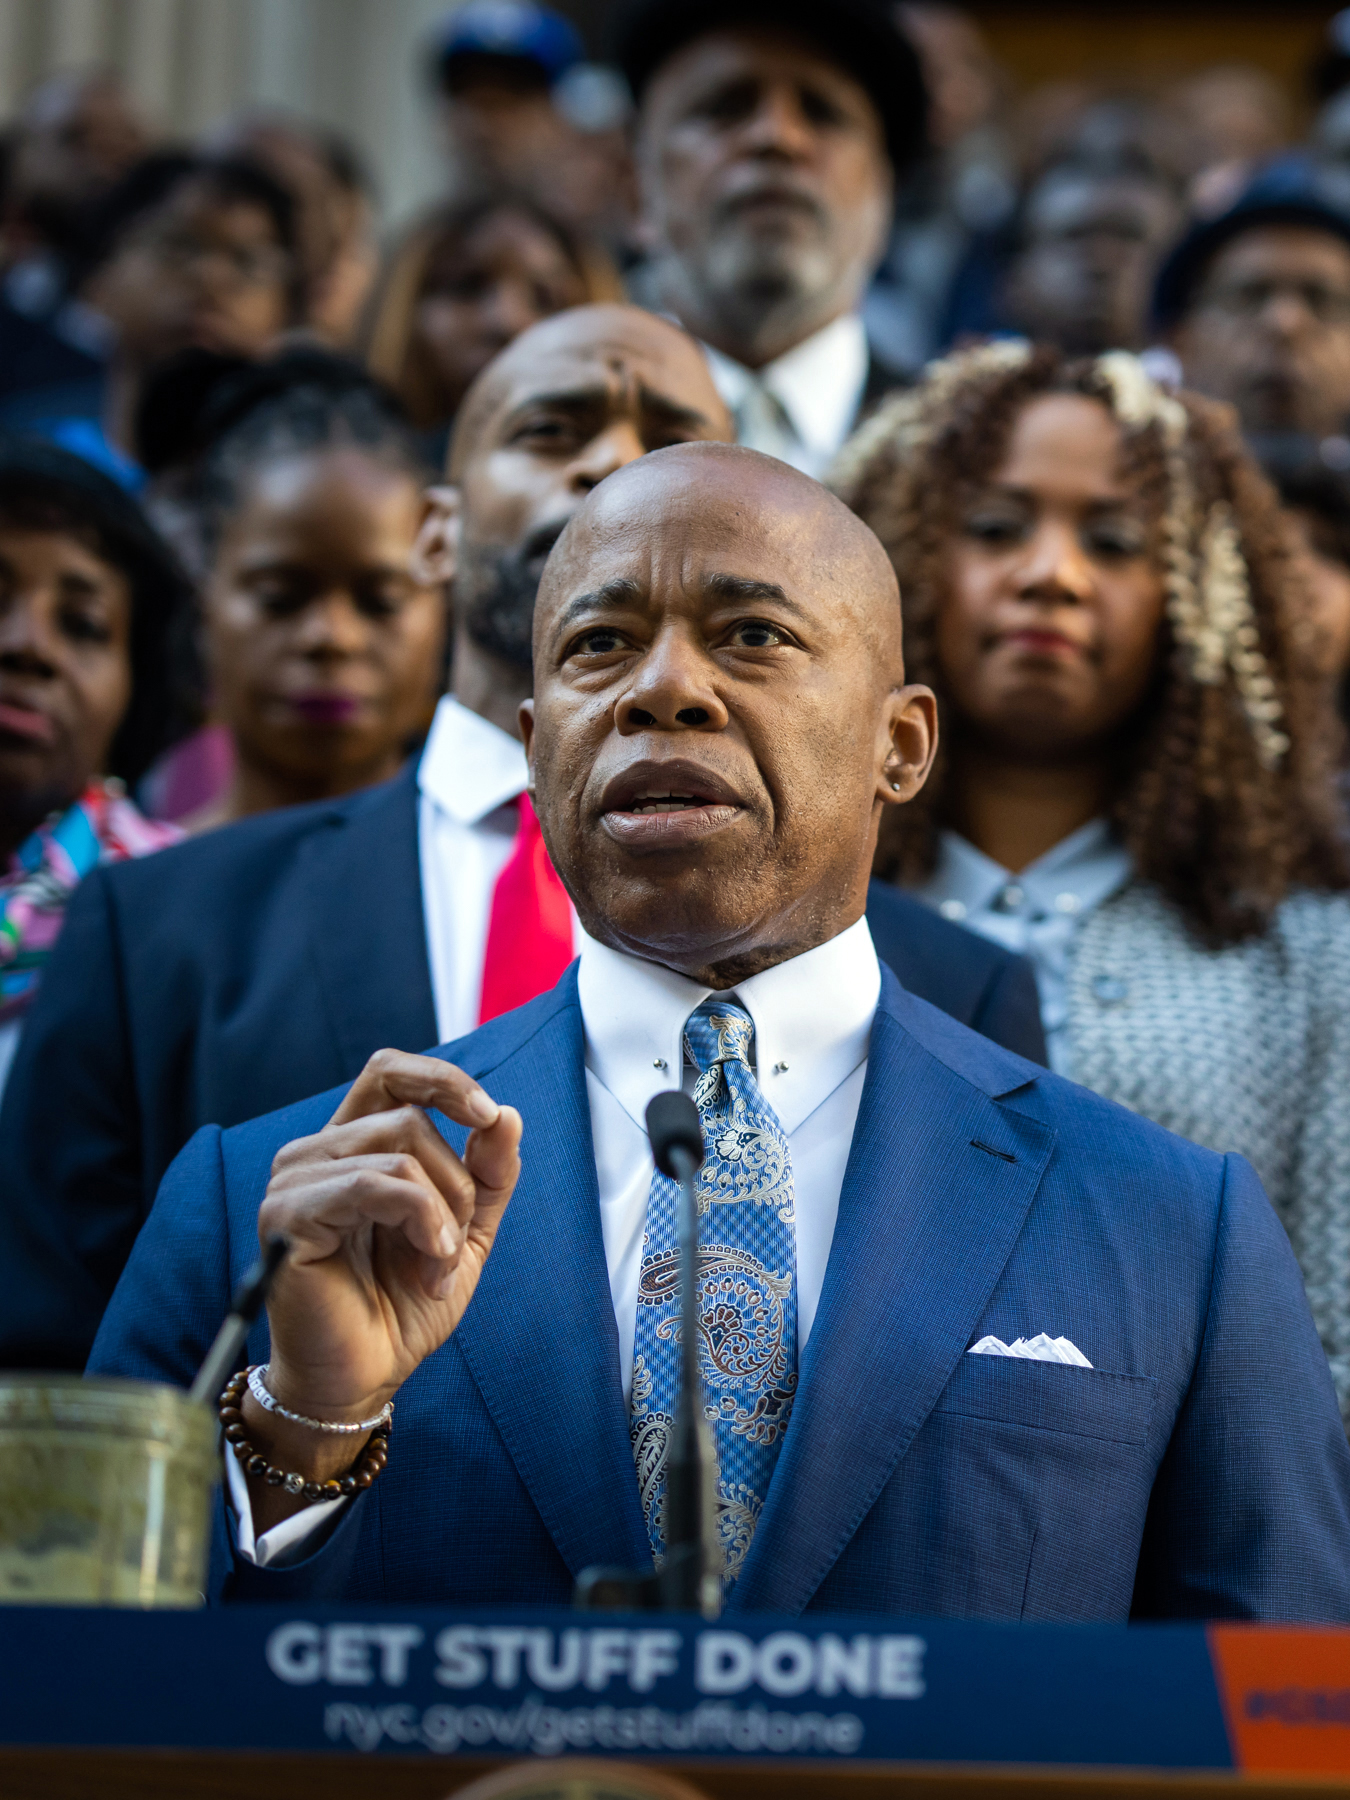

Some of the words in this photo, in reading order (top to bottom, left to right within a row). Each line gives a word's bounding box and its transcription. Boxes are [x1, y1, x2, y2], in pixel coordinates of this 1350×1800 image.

[267, 1622, 422, 1684] GET
[436, 1625, 681, 1691] STUFF
[696, 1630, 926, 1698] DONE
[323, 1696, 863, 1754] nyc.gov/getstuffdone
